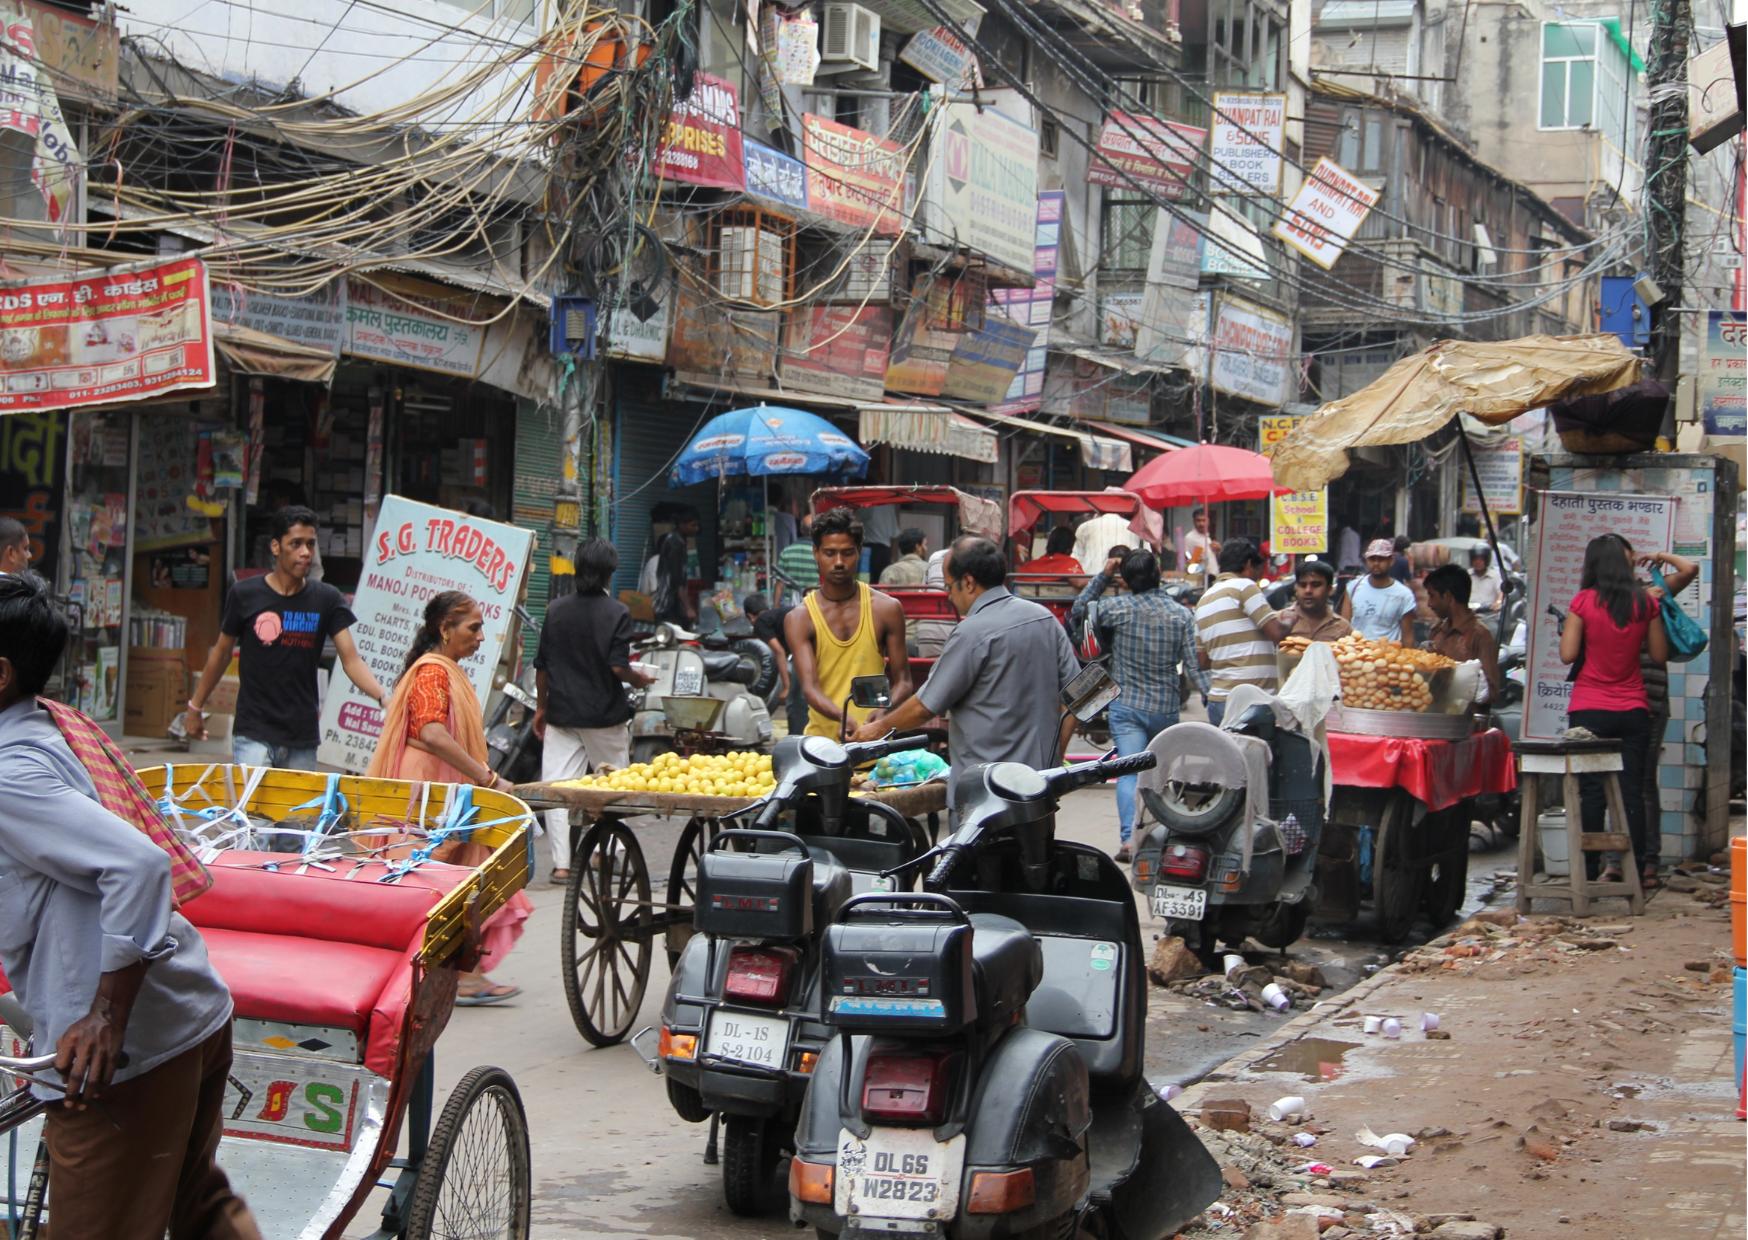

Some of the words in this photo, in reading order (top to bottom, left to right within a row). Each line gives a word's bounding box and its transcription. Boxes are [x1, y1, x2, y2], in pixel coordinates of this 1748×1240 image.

[1264, 108, 1281, 127] RAI
[1213, 146, 1279, 160] PUBLISHERS
[1230, 160, 1263, 170] BOOK
[1308, 198, 1335, 219] AND
[1283, 504, 1317, 513] School
[1551, 493, 1584, 510] देहाती
[1588, 497, 1624, 514] पुस्तक
[1627, 501, 1664, 514] भण्डार
[1277, 525, 1322, 535] COLLEGE
[1283, 538, 1318, 547] BOOKS
[426, 518, 516, 594] TRADERS
[366, 573, 408, 597] MANOJ
[325, 729, 341, 743] Ph.
[1154, 901, 1203, 918] AF3391
[874, 1152, 928, 1174] DL6S
[863, 1178, 937, 1202] W2823
